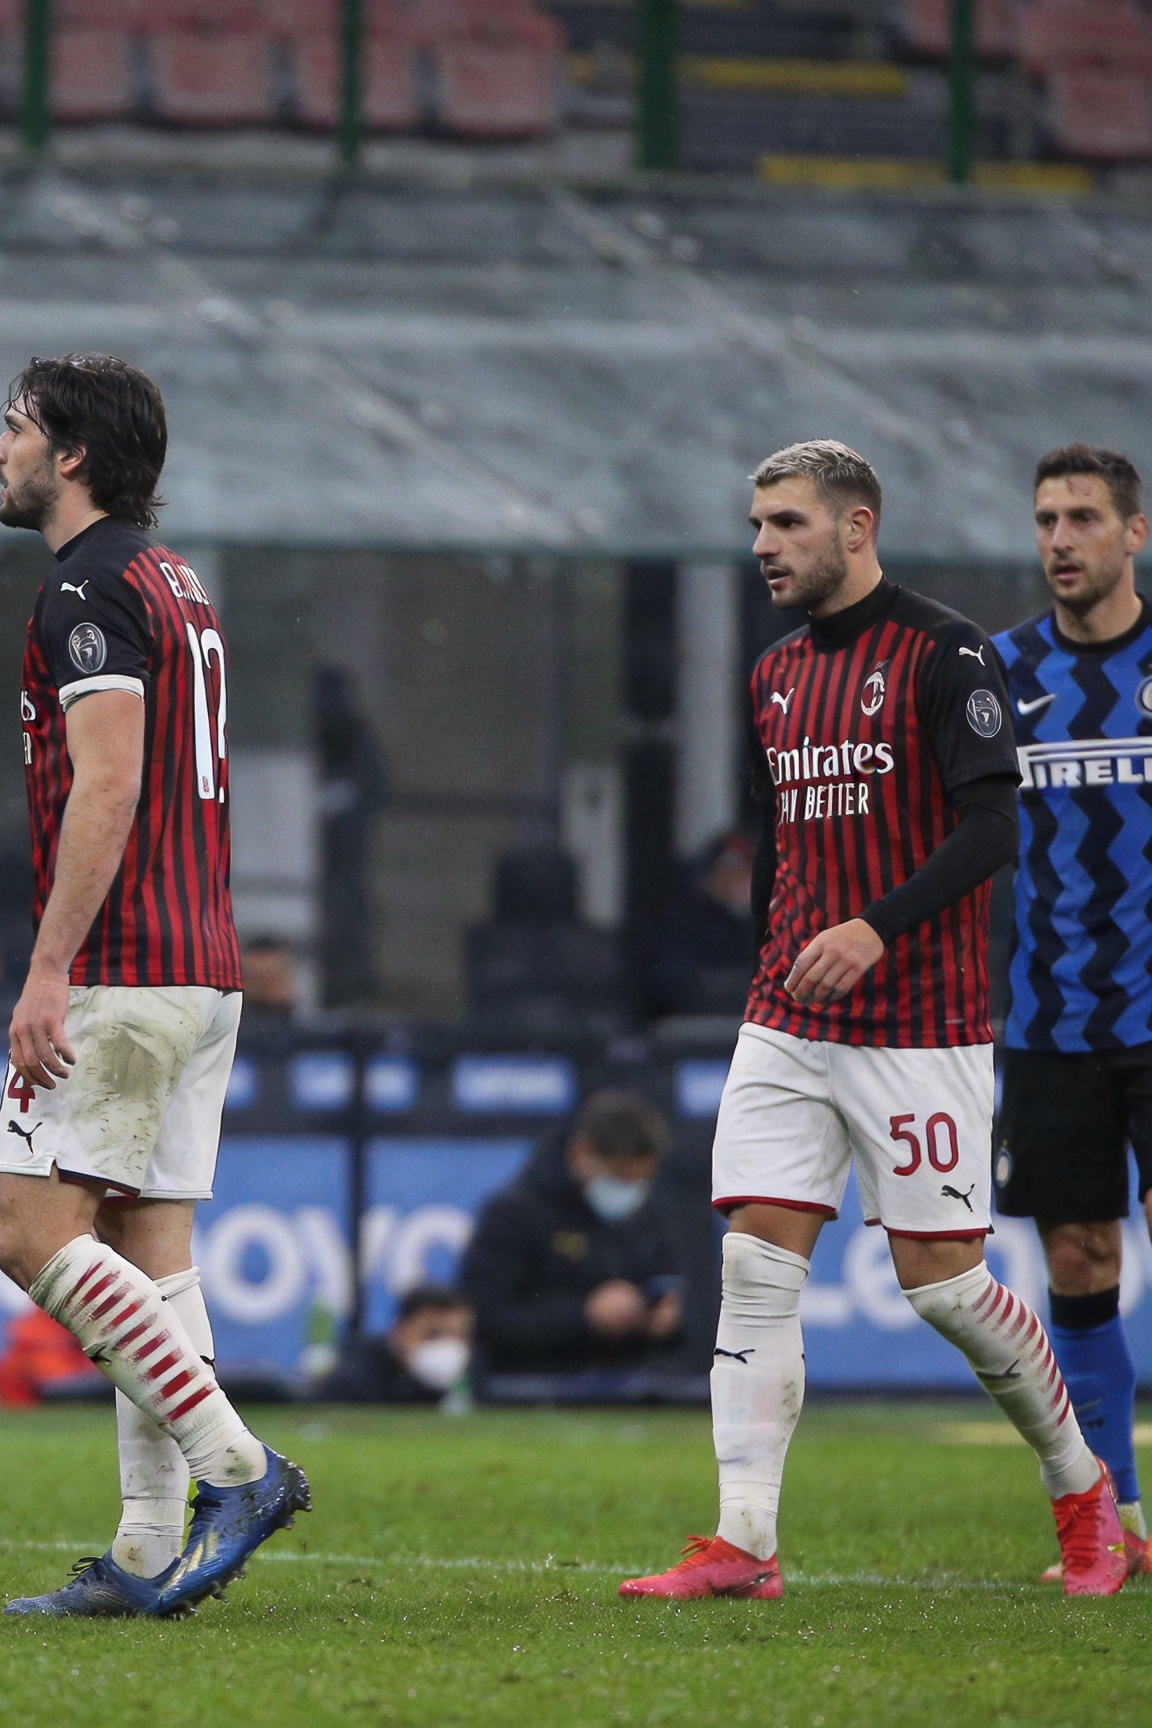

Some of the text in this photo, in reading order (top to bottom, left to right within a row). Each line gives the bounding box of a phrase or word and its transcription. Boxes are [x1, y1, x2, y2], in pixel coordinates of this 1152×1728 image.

[766, 735, 895, 786] Emirates
[804, 782, 869, 820] BETTER
[889, 1111, 959, 1177] 50
